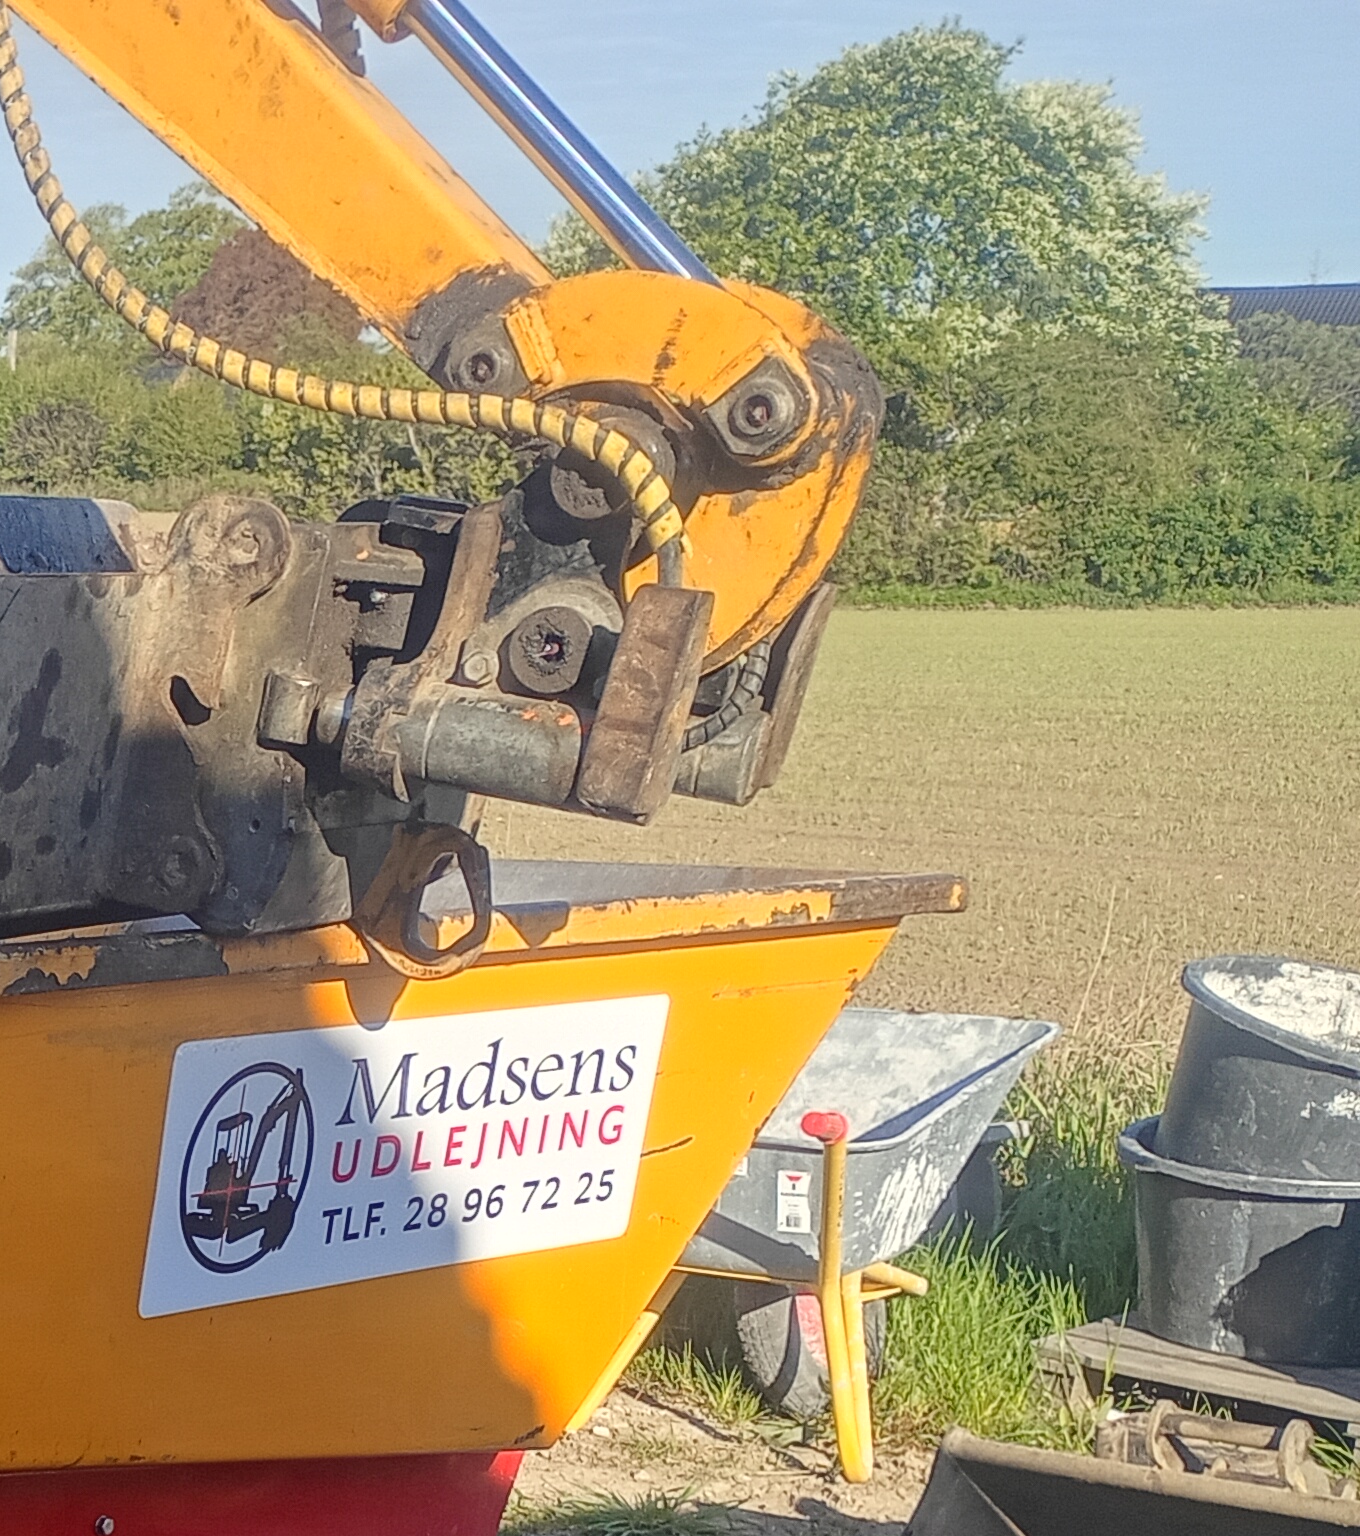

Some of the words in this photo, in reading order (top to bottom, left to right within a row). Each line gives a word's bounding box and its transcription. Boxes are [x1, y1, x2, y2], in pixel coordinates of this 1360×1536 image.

[335, 1037, 637, 1126] Madsens
[332, 1105, 625, 1183] UDLEJNING
[322, 1202, 386, 1244] TLF.
[402, 1193, 448, 1232] 28
[462, 1184, 506, 1223] 96
[522, 1177, 561, 1213] 72
[574, 1169, 615, 1205] 25
